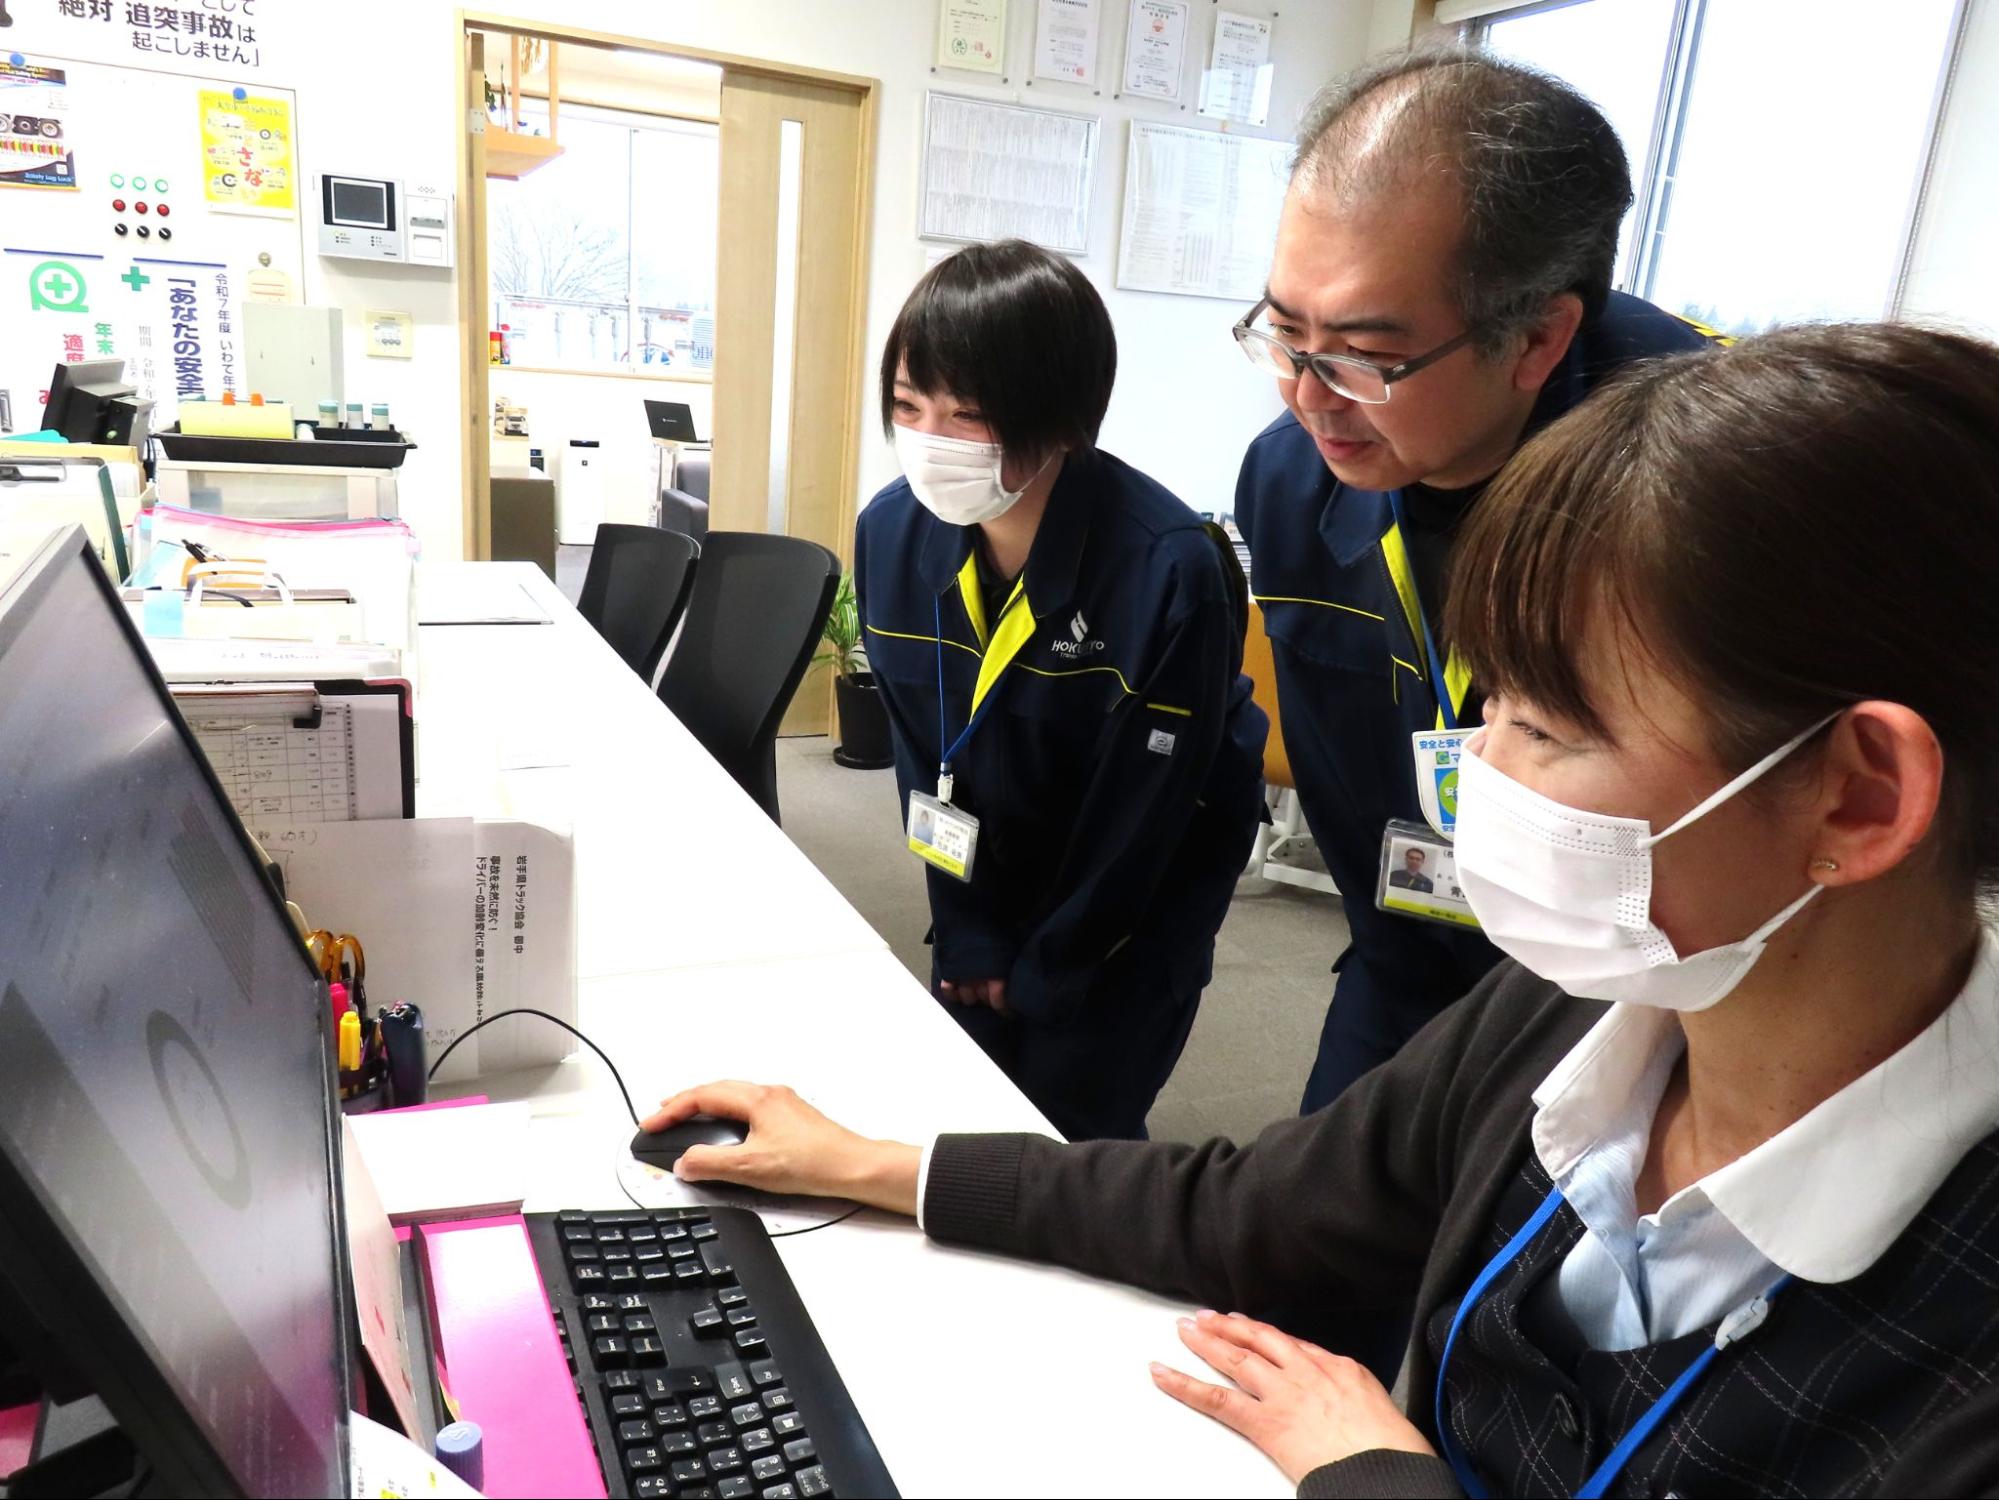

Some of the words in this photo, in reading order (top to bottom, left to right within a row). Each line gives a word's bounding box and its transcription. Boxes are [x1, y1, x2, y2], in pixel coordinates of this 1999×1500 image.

[59, 0, 112, 22] 絶対
[126, 2, 257, 43] 追突事故は
[132, 31, 260, 67] 起こしません」
[94, 322, 115, 355] 年末
[168, 277, 206, 397] 「あなたの安全
